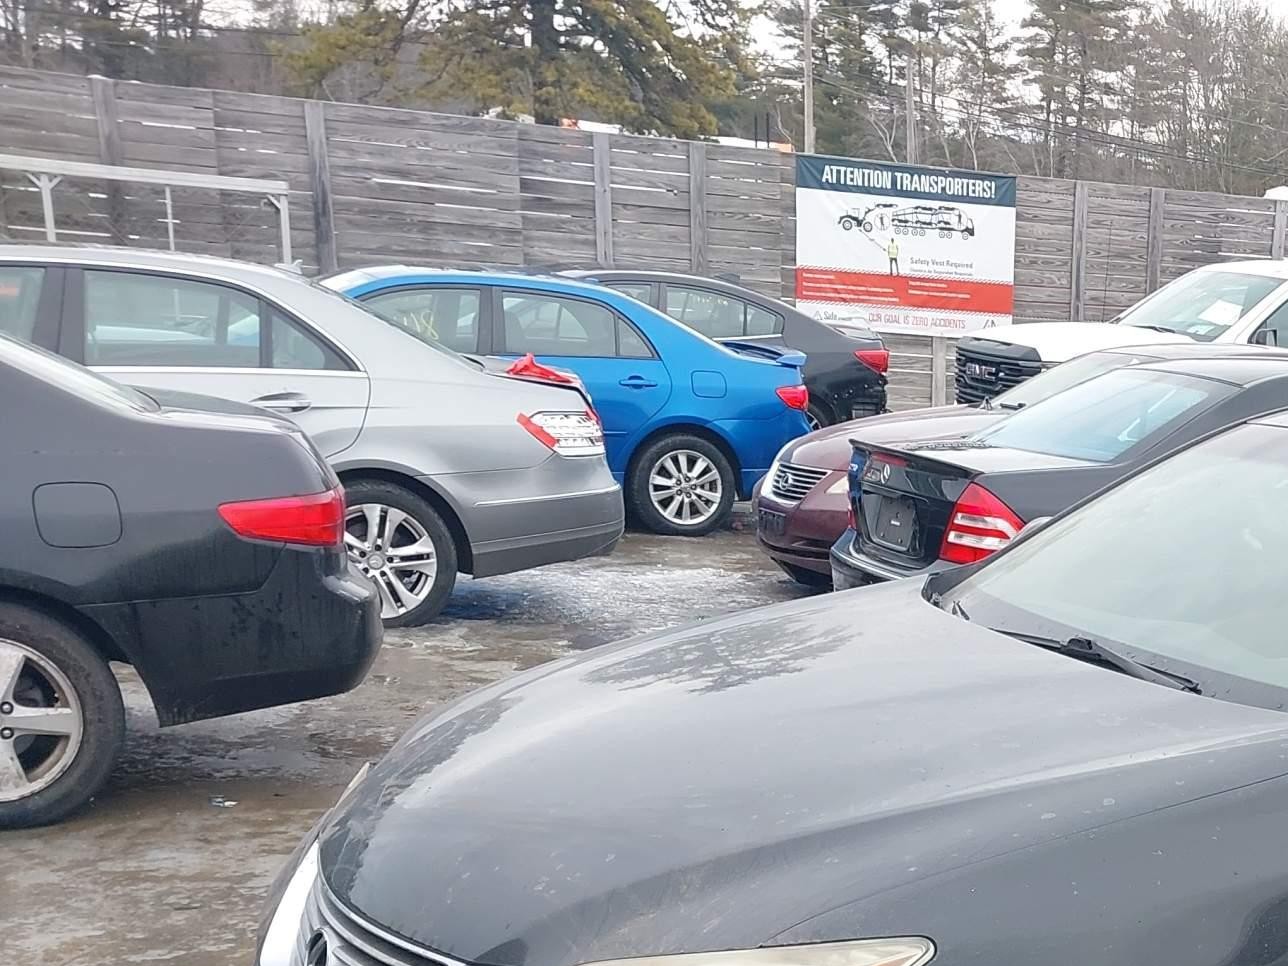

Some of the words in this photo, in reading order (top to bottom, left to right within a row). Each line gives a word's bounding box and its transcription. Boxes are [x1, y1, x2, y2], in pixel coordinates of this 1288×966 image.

[822, 165, 892, 190] ATTENTION
[895, 172, 996, 199] TRANSPORTERS!
[910, 257, 930, 267] Safety
[931, 259, 945, 267] Vest
[946, 260, 974, 269] Required
[868, 312, 882, 323] OUR
[884, 313, 901, 325] GOAL
[903, 314, 910, 325] IS
[912, 316, 928, 327] ZERO
[931, 317, 966, 329] ACCIDENTS
